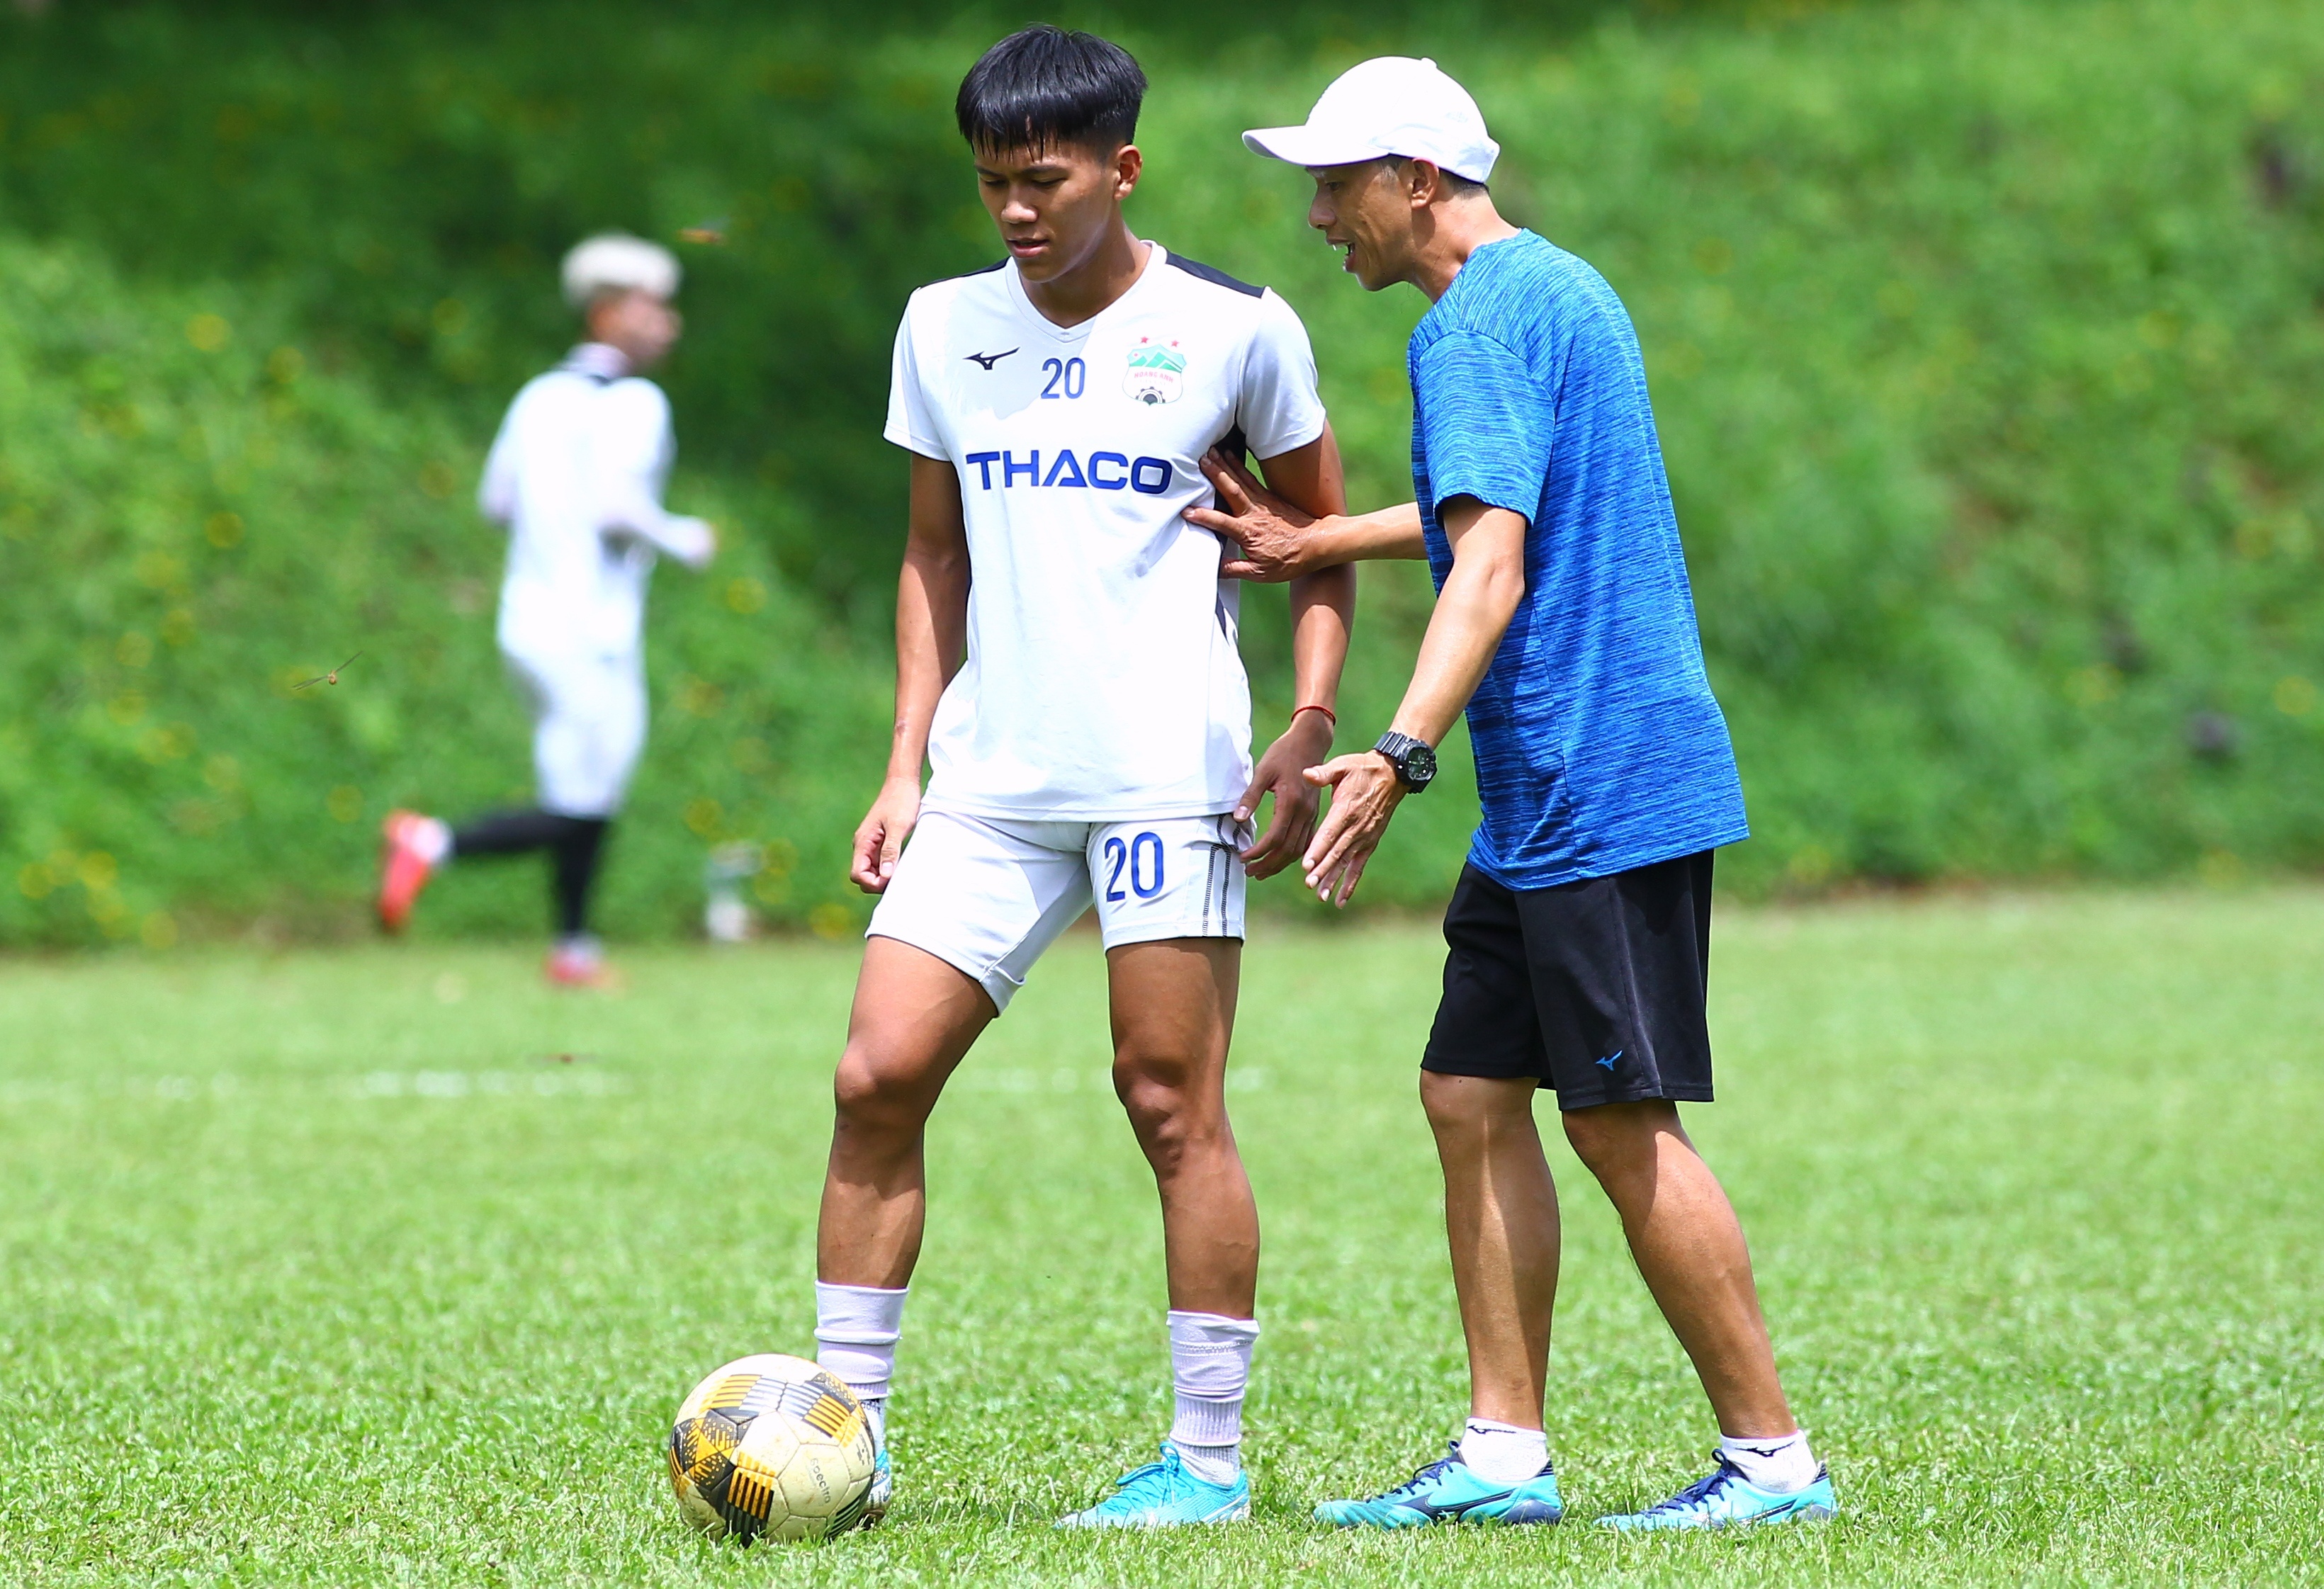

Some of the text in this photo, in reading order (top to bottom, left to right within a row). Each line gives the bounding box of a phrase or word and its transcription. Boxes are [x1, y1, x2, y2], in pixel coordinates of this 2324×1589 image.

[1041, 357, 1085, 399] 20
[1159, 373, 1173, 383] ANH
[966, 449, 1173, 494] THACO
[1105, 831, 1164, 903] 20
